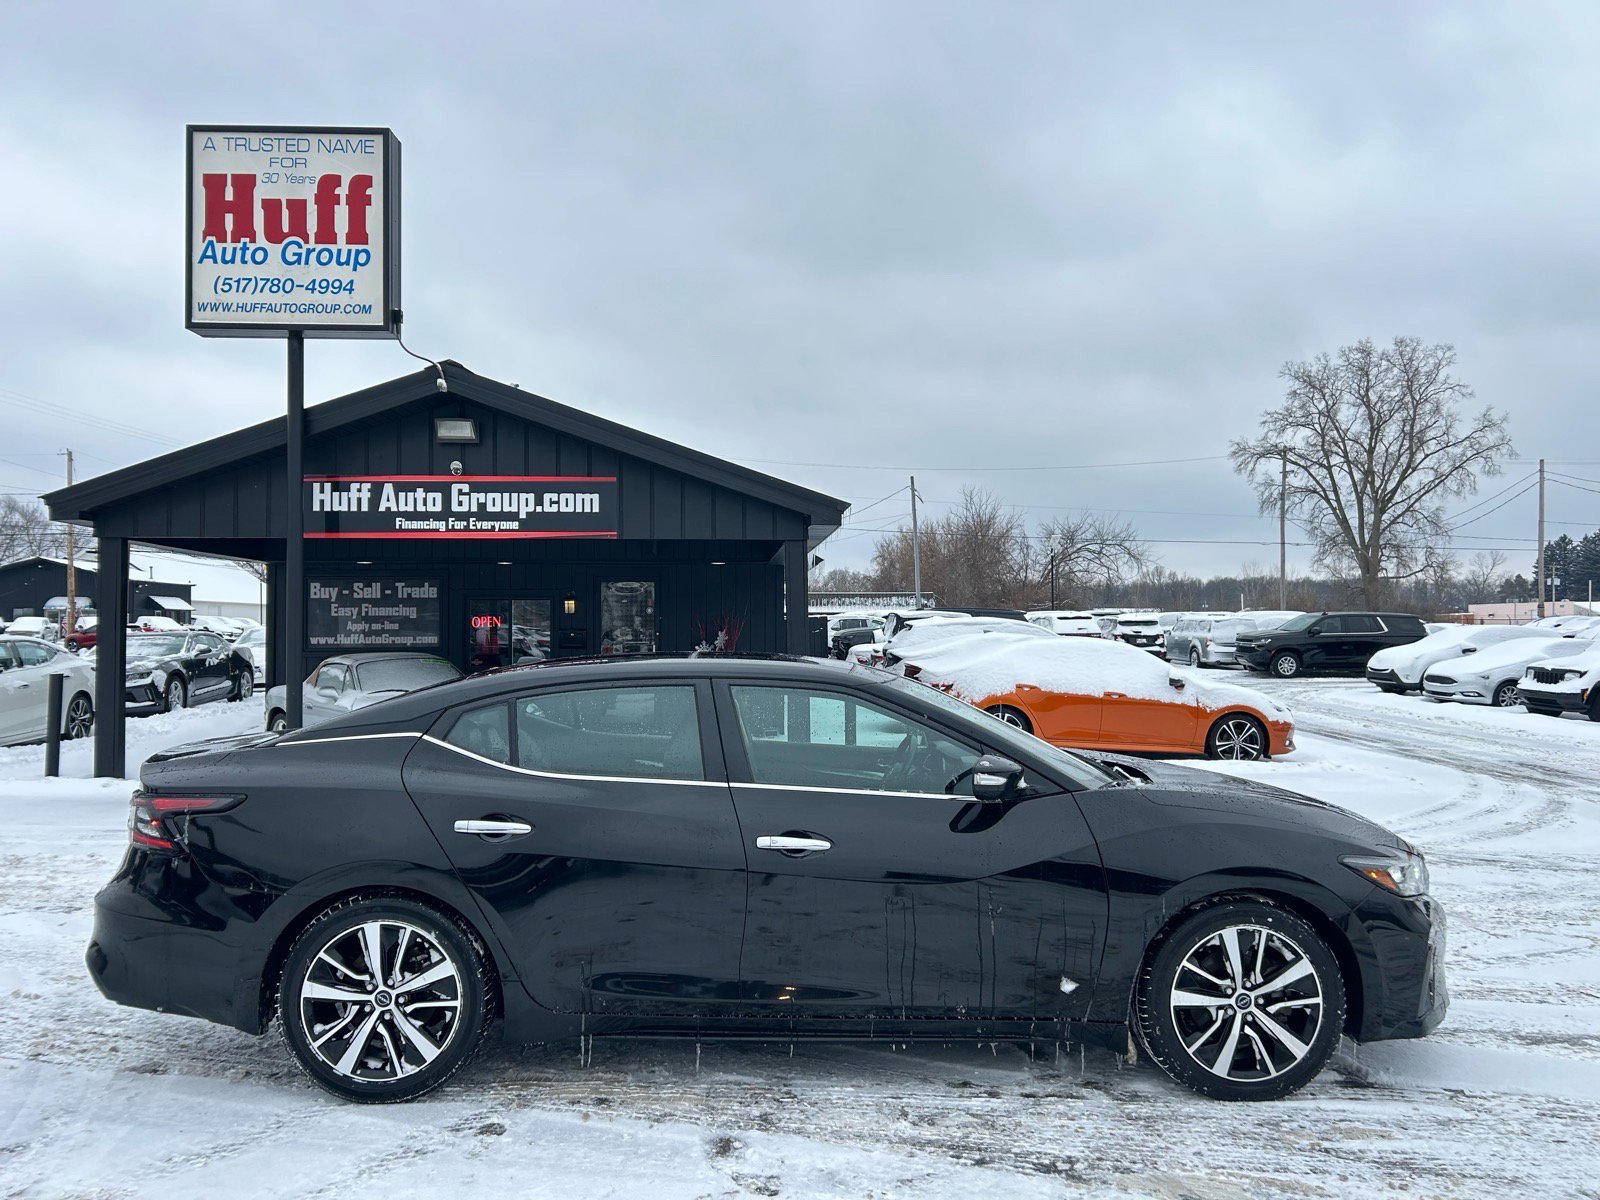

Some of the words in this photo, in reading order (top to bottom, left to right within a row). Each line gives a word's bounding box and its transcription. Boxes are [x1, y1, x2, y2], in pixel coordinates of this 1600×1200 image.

[203, 137, 216, 151] A
[223, 137, 311, 153] TRUSTED
[317, 138, 375, 154] NAME
[269, 157, 307, 169] FOR
[261, 172, 279, 184] 30
[284, 173, 317, 185] Years
[202, 173, 373, 245] Huff
[197, 240, 269, 266] Auto
[280, 240, 371, 272] Group
[213, 275, 355, 295] (517)780-4994
[197, 302, 372, 315] WWW.HUFFAUTOGROUP.COM
[312, 482, 371, 512] Huff
[378, 482, 442, 512] Auto
[451, 483, 600, 519] Group.com
[395, 517, 446, 532] Financing
[448, 518, 467, 529] For
[469, 517, 519, 532] Everyone
[310, 582, 339, 602] Buy
[352, 582, 381, 599] Sell
[395, 582, 438, 599] Trade
[330, 603, 359, 619] Easy
[361, 603, 417, 619] Financing
[346, 621, 369, 632] Apply
[371, 621, 399, 630] on-line
[471, 616, 501, 628] OPEN
[309, 634, 438, 646] www.HuffAutoGroup.com
